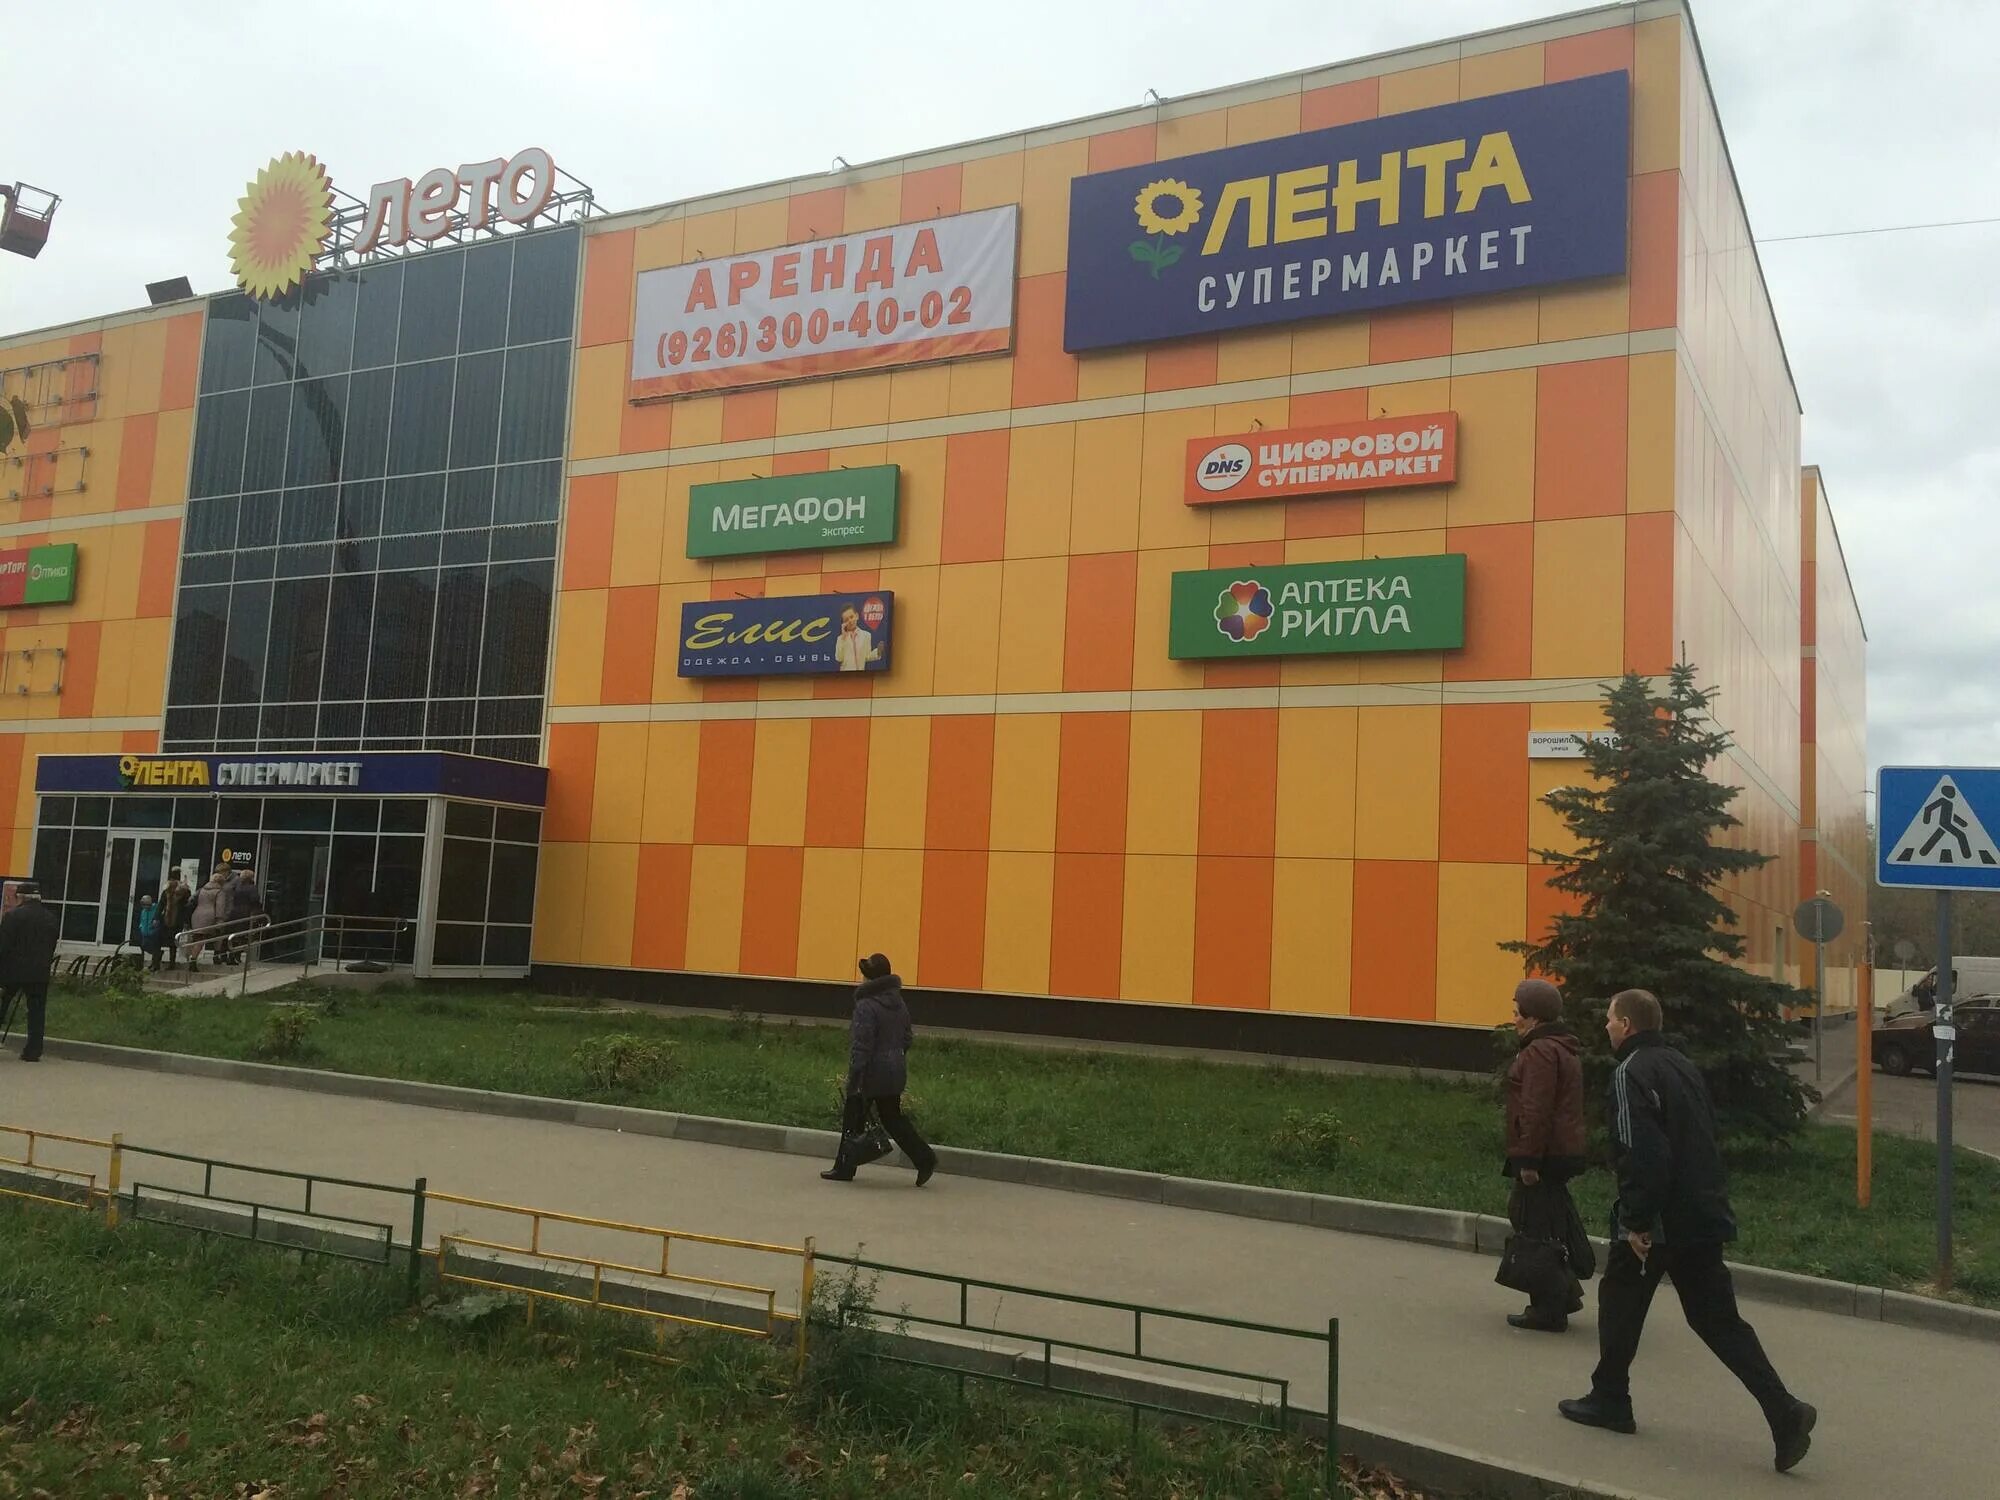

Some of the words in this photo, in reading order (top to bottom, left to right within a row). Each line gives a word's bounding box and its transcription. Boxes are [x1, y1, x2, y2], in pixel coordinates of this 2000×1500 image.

[353, 147, 555, 254] лето
[1201, 130, 1532, 256] ЛЕНТА
[684, 228, 943, 313] АРЕНДА
[1198, 225, 1532, 313] СУПЕРМАРКЕТ
[1259, 424, 1444, 467] ЦИФРОВОЙ
[1205, 458, 1244, 475] DNS
[1258, 455, 1443, 487] СУПЕРМАРКЕТ
[821, 524, 865, 537] экспресс
[1279, 575, 1412, 605] АПТЕКА
[685, 613, 832, 650] Елис
[1281, 605, 1411, 638] РИГЛА
[684, 656, 752, 666] ОДЕЖДА
[774, 654, 831, 663] ОБУВЬ
[1532, 737, 1579, 745] ВОРОШИЛО
[133, 760, 210, 786] ЛЕНТА
[217, 762, 362, 786] СУПЕРМАРКЕТ
